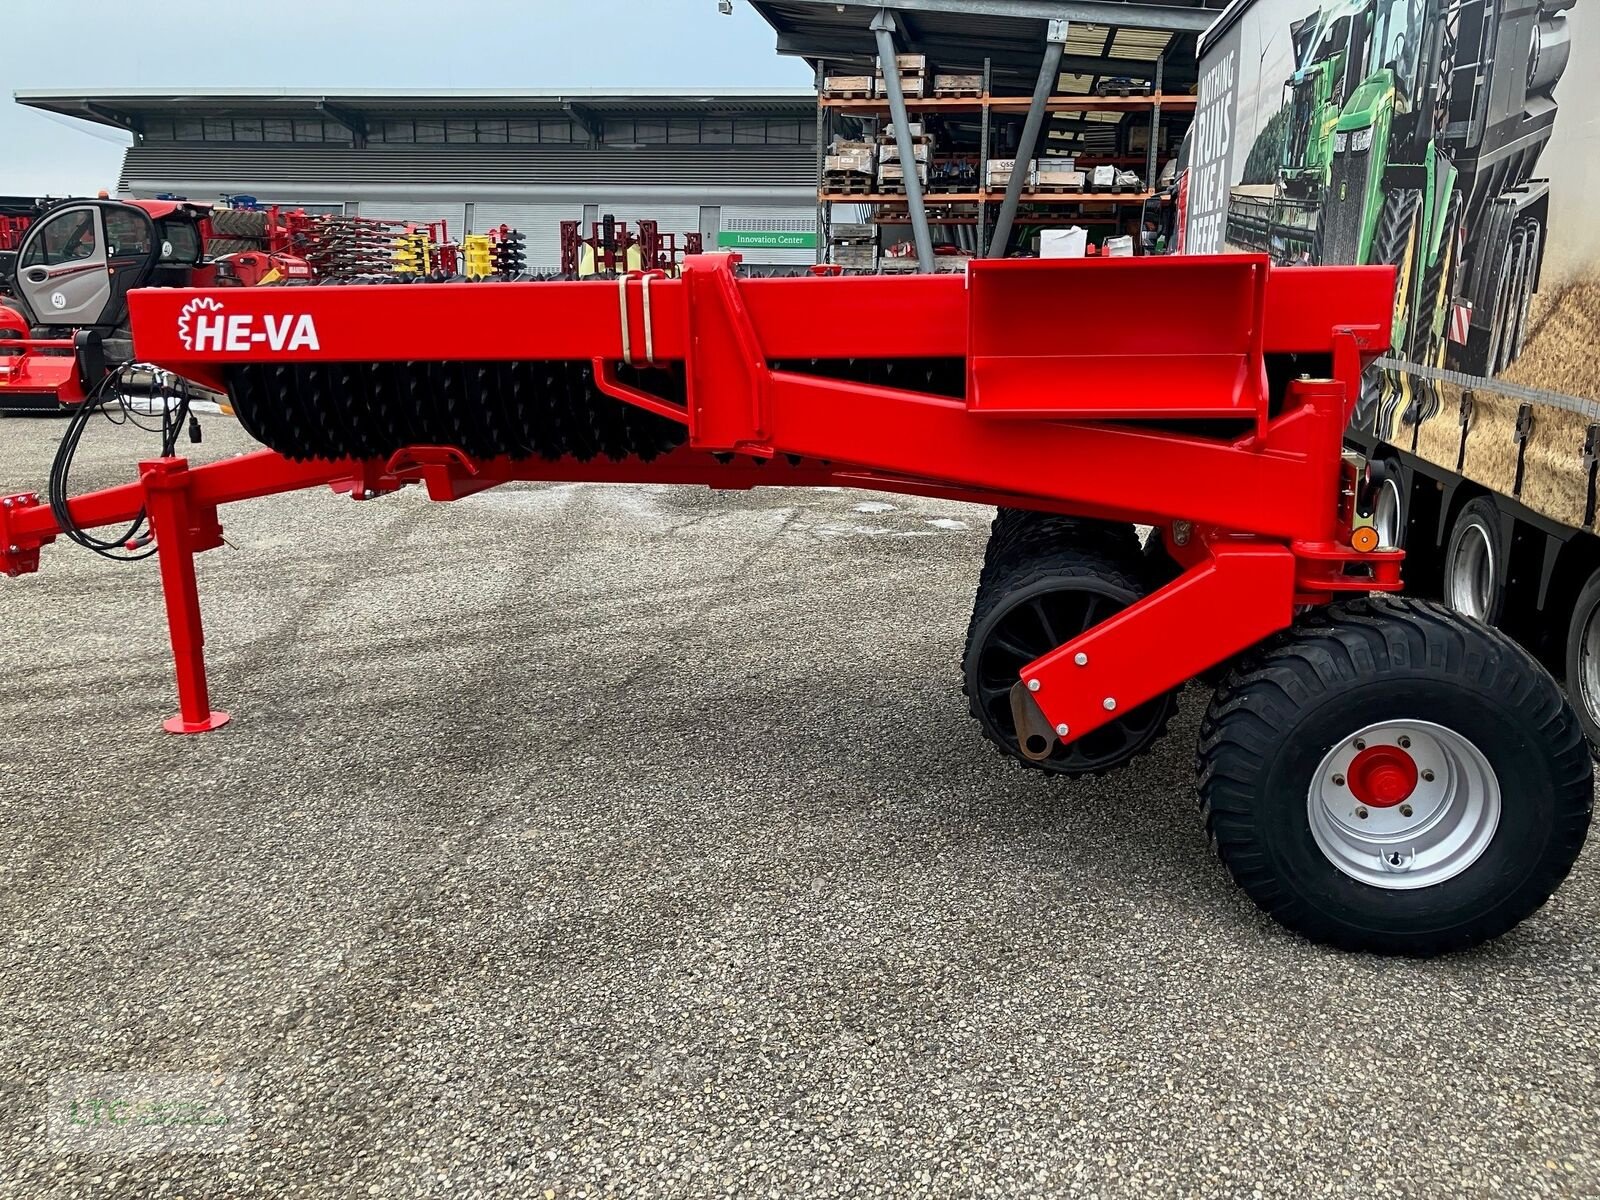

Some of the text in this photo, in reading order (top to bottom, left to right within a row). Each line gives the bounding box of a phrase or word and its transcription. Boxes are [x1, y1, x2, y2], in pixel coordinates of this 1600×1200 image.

[1201, 50, 1234, 109] NOTHING
[1197, 90, 1233, 169] RUNS
[1193, 159, 1226, 216] LIKE A
[164, 244, 171, 255] 40
[737, 235, 804, 244] Innovation Center
[1190, 212, 1222, 254] DEERE
[54, 295, 64, 306] 40
[195, 314, 320, 351] HE-VA
